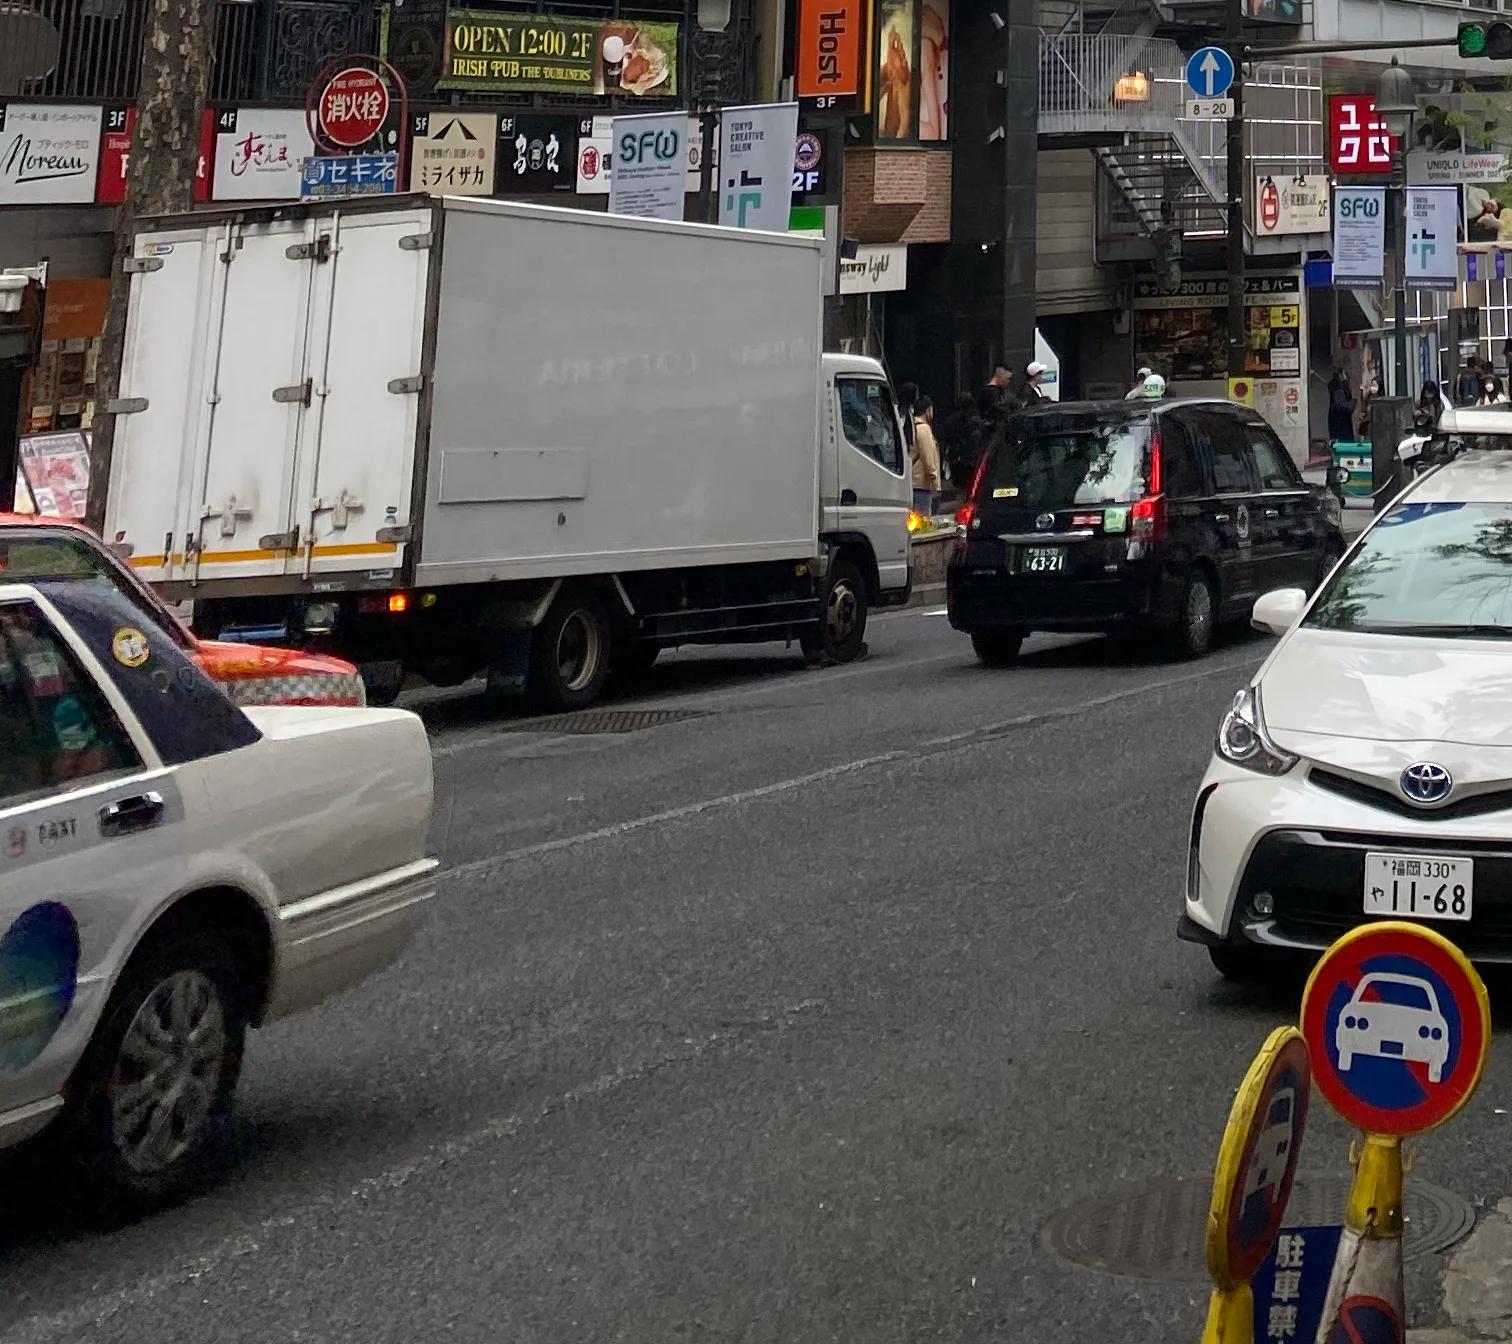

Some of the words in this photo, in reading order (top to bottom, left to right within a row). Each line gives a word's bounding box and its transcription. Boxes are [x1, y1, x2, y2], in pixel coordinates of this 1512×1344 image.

[453, 24, 511, 55] OPEN
[518, 27, 566, 58] 12:00
[570, 30, 594, 59] 2F
[817, 9, 847, 85] Host
[452, 58, 488, 78] IRISH
[489, 59, 520, 79] PUB
[521, 65, 541, 80] THE
[327, 91, 383, 124] 消火栓
[816, 96, 836, 109] 3F
[108, 111, 125, 127] 3F
[219, 112, 236, 128] 4F
[415, 117, 428, 131] 5F
[501, 118, 514, 132] 6F
[580, 120, 592, 133] 6F
[730, 122, 753, 132] TOKYO
[730, 132, 765, 143] CREATIVE
[730, 142, 752, 153] SALON
[1426, 159, 1460, 170] UNIQLO
[1462, 158, 1500, 169] LifeWear
[421, 164, 485, 187] ミライザカ
[792, 171, 820, 191] 2F
[1280, 308, 1297, 325] 5F
[1030, 555, 1064, 571] 63-21
[1391, 859, 1421, 877] 福岡
[1423, 862, 1450, 879] 330
[1370, 886, 1385, 903] や
[1391, 880, 1466, 915] 11-68
